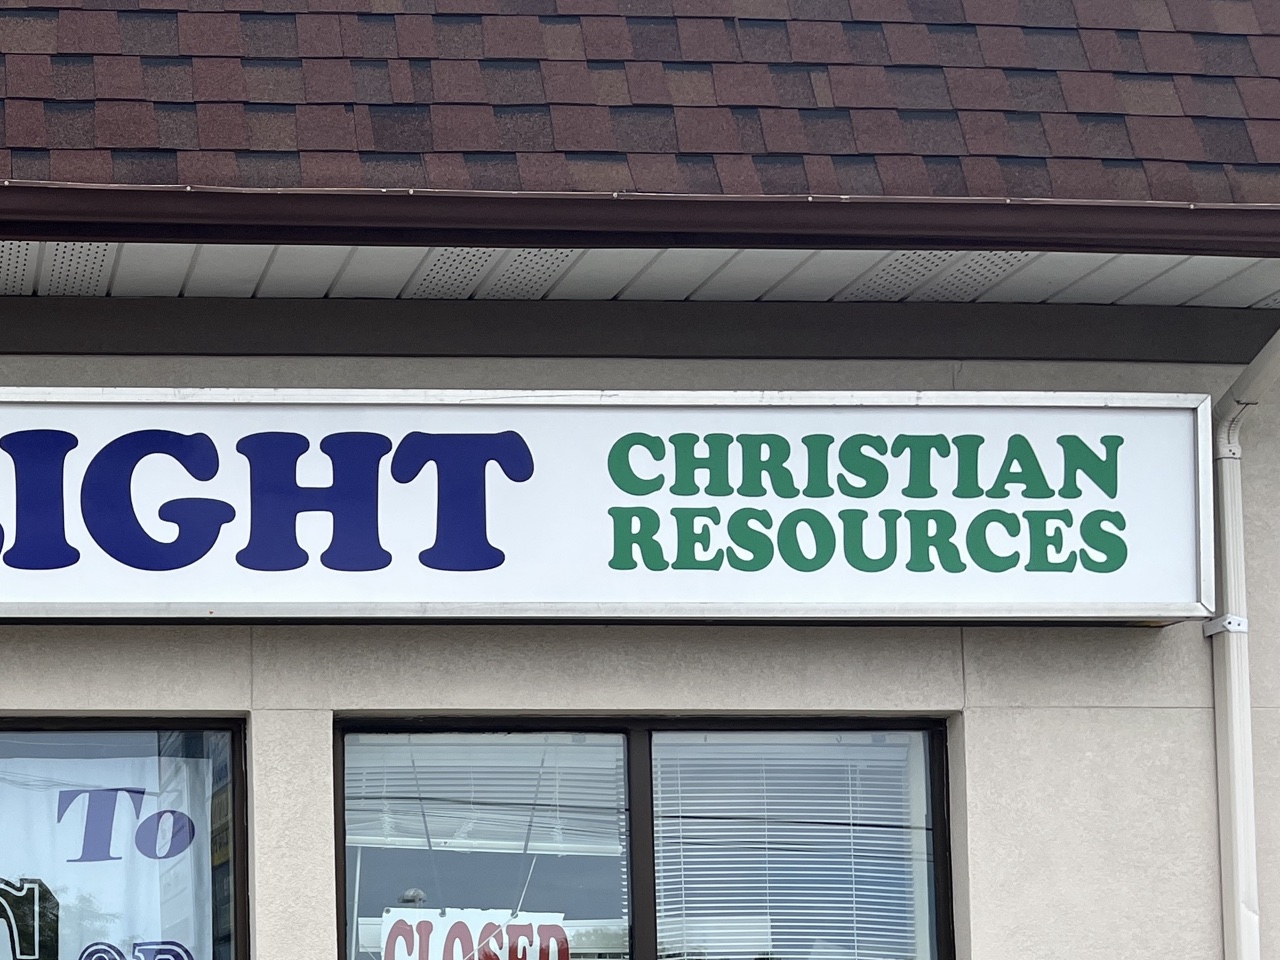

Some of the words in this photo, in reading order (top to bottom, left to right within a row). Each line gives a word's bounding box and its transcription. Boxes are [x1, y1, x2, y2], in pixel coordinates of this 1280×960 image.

[608, 432, 1124, 499] CHRISTIAN
[608, 506, 1128, 573] RESOURCES
[56, 787, 195, 862] To
